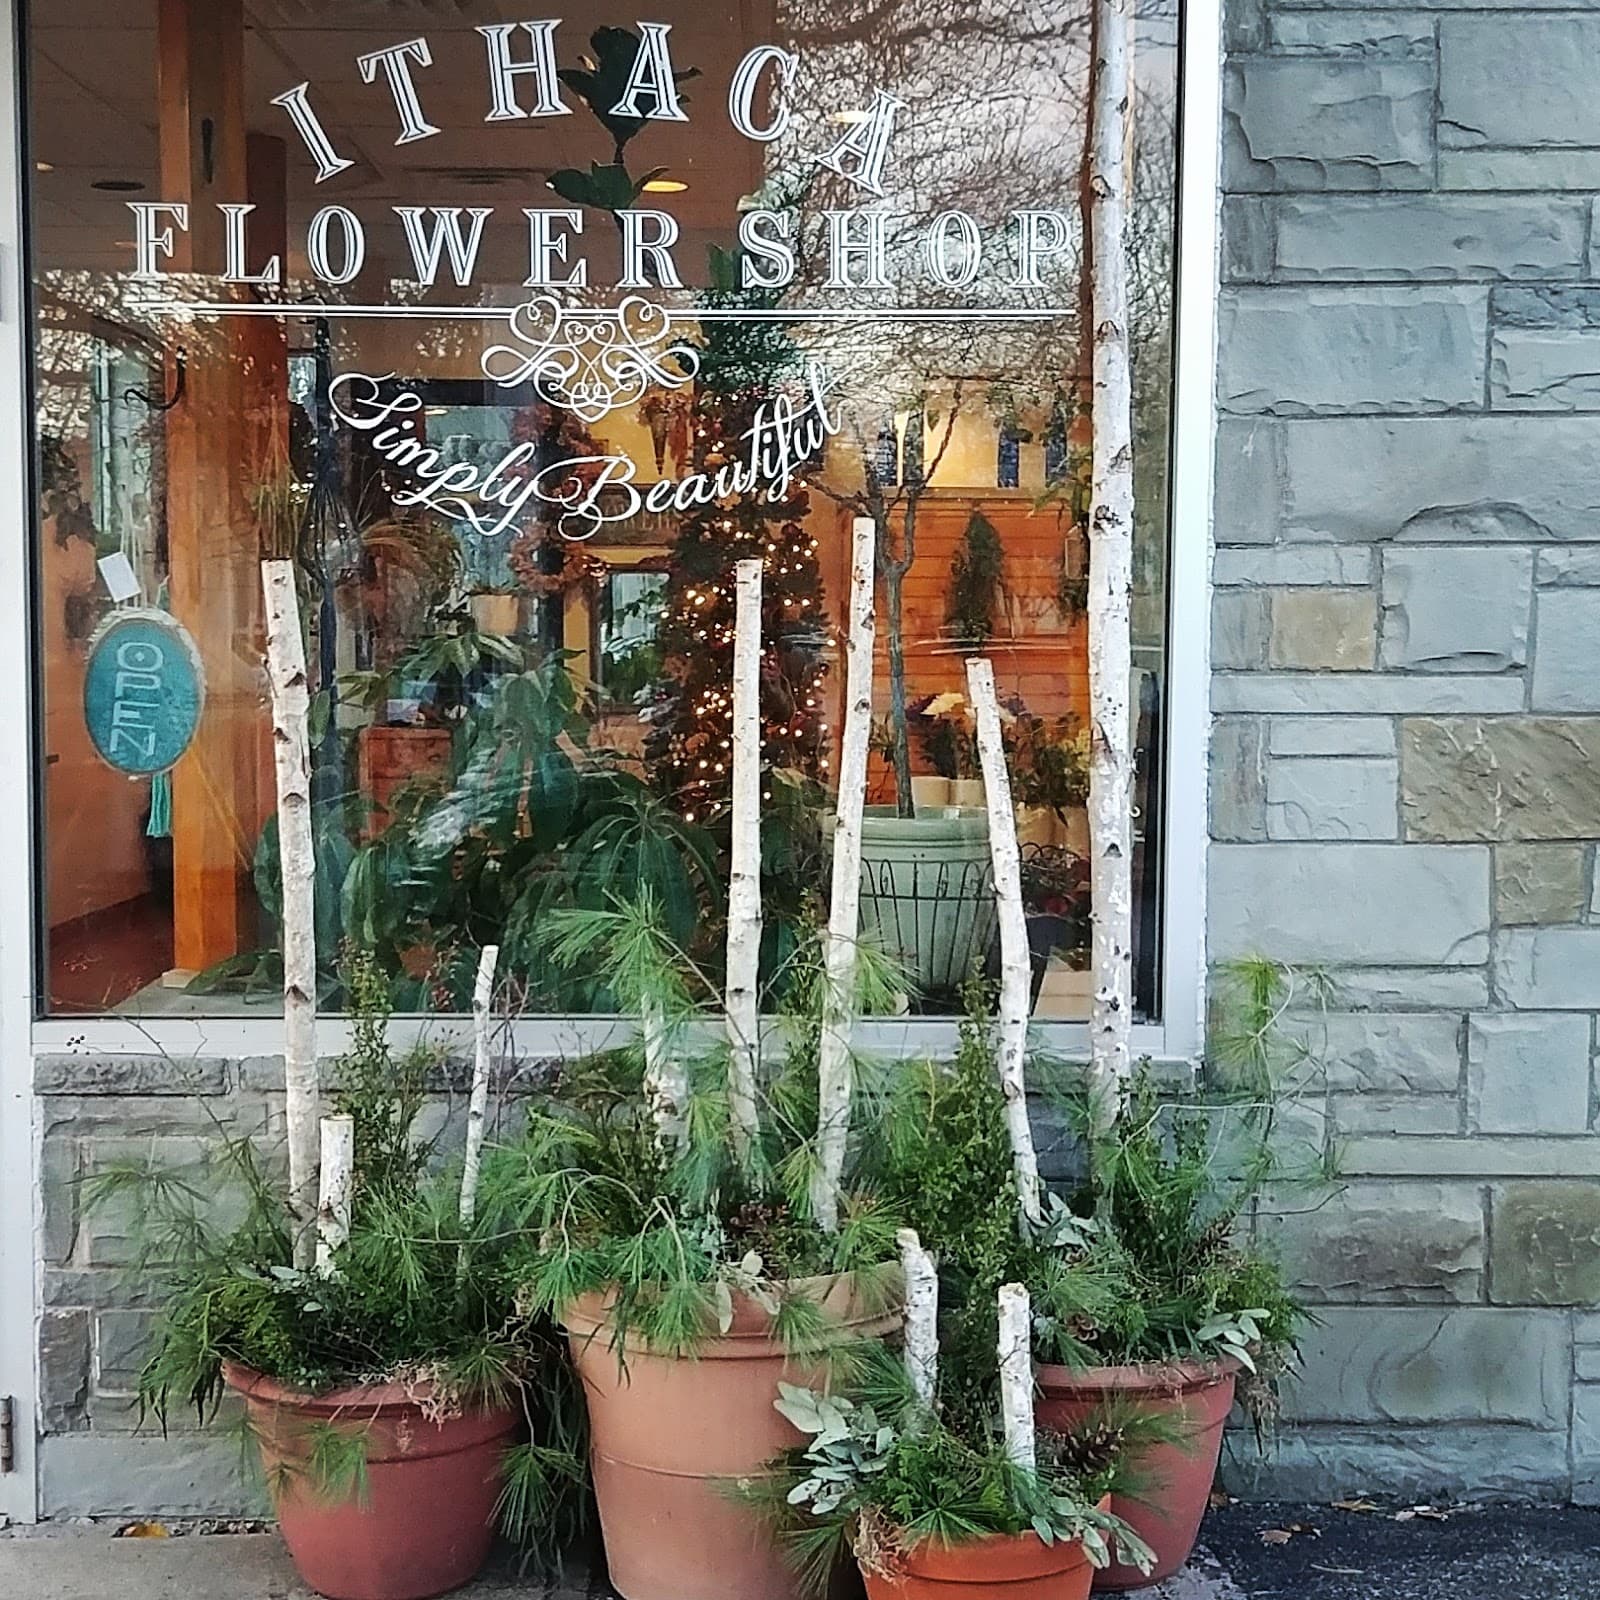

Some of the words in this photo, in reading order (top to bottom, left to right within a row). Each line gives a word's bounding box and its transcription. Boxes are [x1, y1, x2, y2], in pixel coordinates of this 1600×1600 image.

[271, 18, 905, 194] ITHACA
[125, 201, 682, 290] FLOWER
[738, 209, 1072, 291] SHOP
[328, 371, 533, 537] Simply
[534, 361, 862, 541] Beautiful
[109, 642, 163, 757] OPEN
